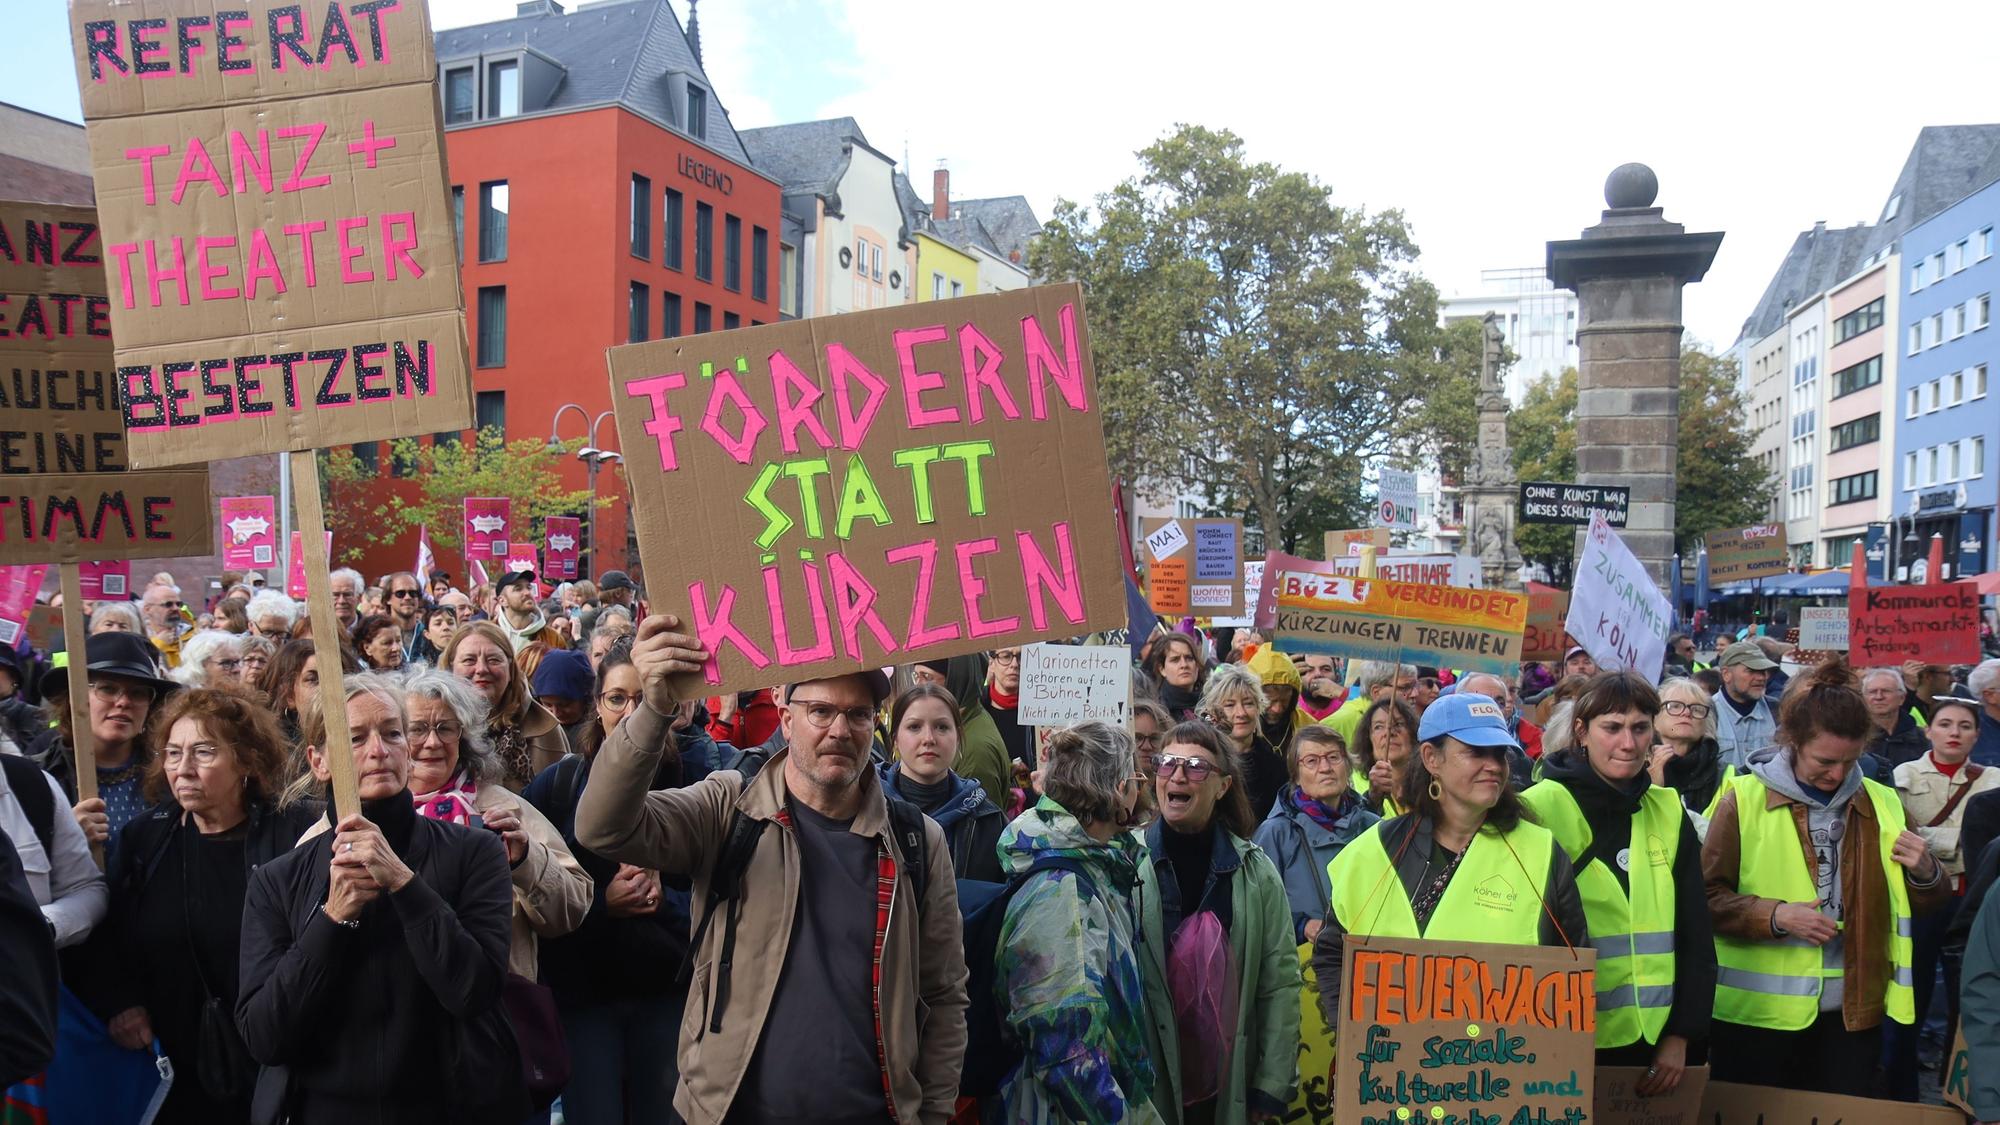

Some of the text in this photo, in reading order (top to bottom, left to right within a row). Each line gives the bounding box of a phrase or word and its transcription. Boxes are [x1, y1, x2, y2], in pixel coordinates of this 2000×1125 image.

[84, 0, 402, 83] REFERAT
[125, 120, 396, 206] TANZ +
[678, 152, 733, 196] LEGEND
[109, 211, 424, 308] THEATER
[118, 340, 436, 433] BESETZEN
[625, 303, 1088, 472] FÖRDERN
[743, 440, 995, 550] STATT
[1525, 486, 1556, 498] OHNE
[1563, 488, 1599, 502] KUNST
[1712, 564, 1740, 575] NICHT
[687, 521, 1086, 686] KÜRZEN
[1595, 550, 1671, 645] ZUSAMMEN
[1866, 586, 1977, 612] Kommunale
[1276, 611, 1509, 656] KÜRZUNGEN TRENNEN
[1597, 611, 1638, 668] KÖLN
[1862, 637, 1921, 658] förderung
[1026, 647, 1118, 670] Marionetten
[1026, 671, 1116, 689] gehören auf die
[1022, 702, 1124, 723] Nicht in die Politik!
[1351, 950, 1596, 1033] FEUERWACHE
[1356, 1025, 1401, 1074] für
[1523, 1070, 1584, 1096] und
